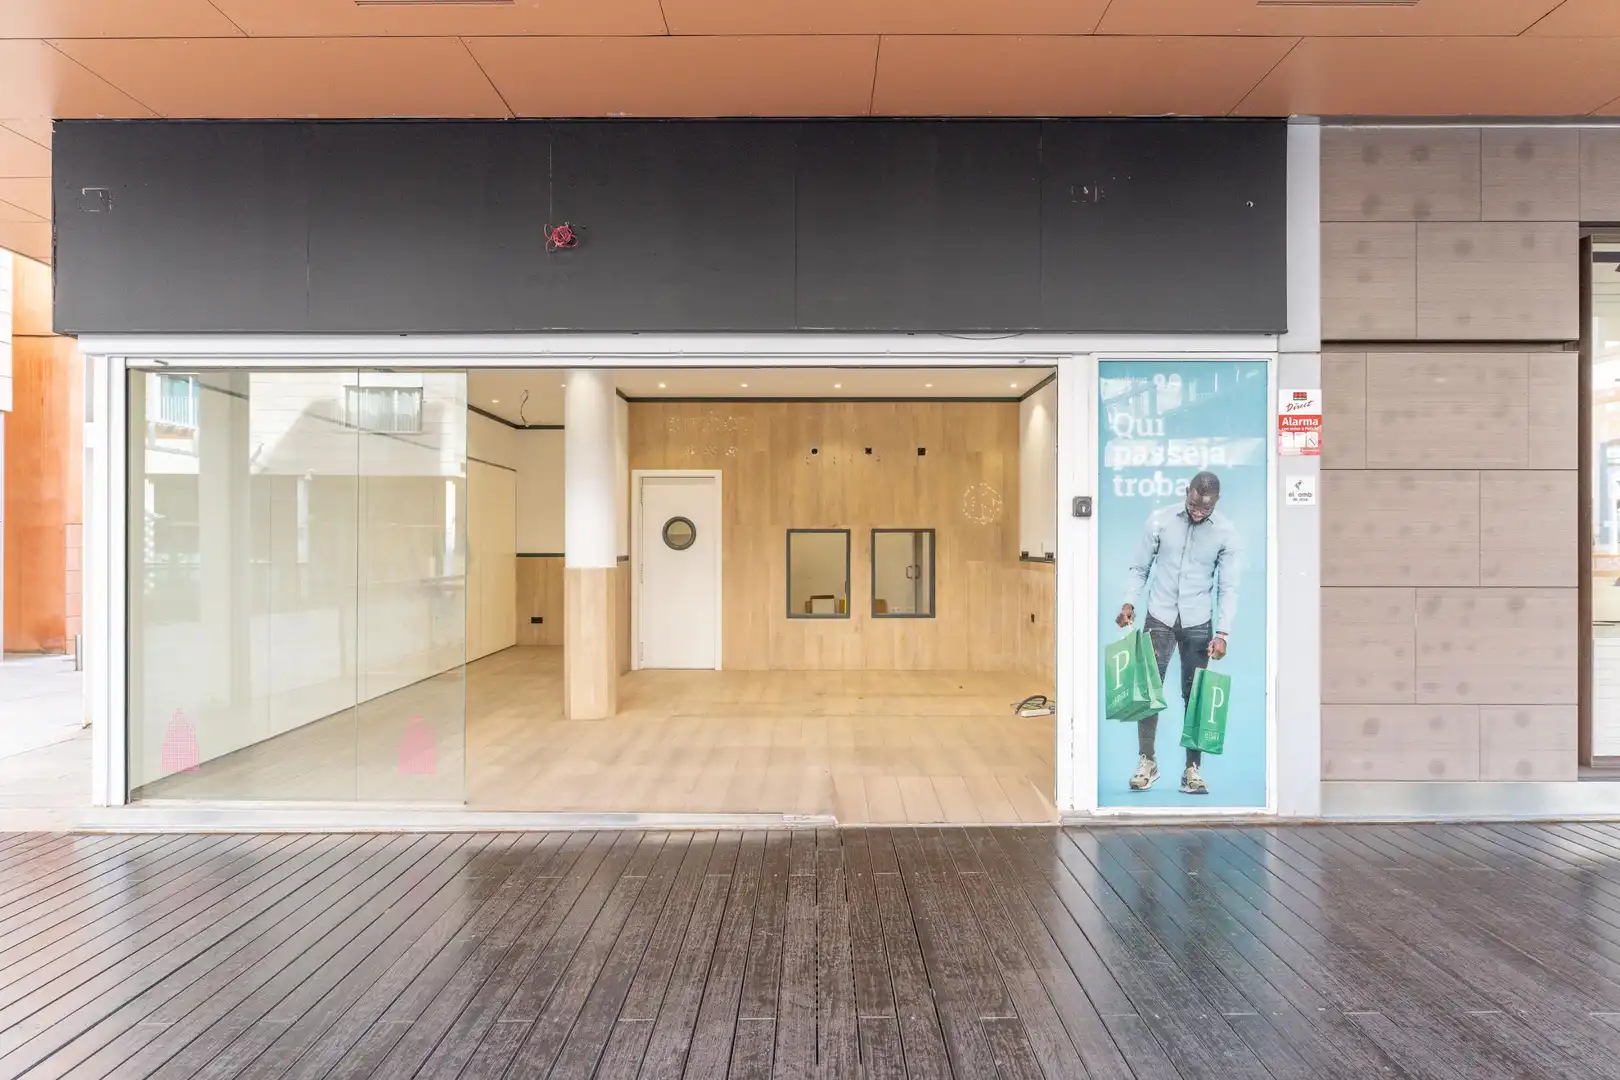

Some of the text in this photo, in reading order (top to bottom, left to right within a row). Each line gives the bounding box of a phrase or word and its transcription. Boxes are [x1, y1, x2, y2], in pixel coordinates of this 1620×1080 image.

[1286, 400, 1314, 412] Direct
[1112, 412, 1165, 439] Qui
[1281, 416, 1319, 426] Alarma
[1112, 472, 1188, 498] troba
[1112, 650, 1130, 691] P
[1207, 686, 1224, 724] P
